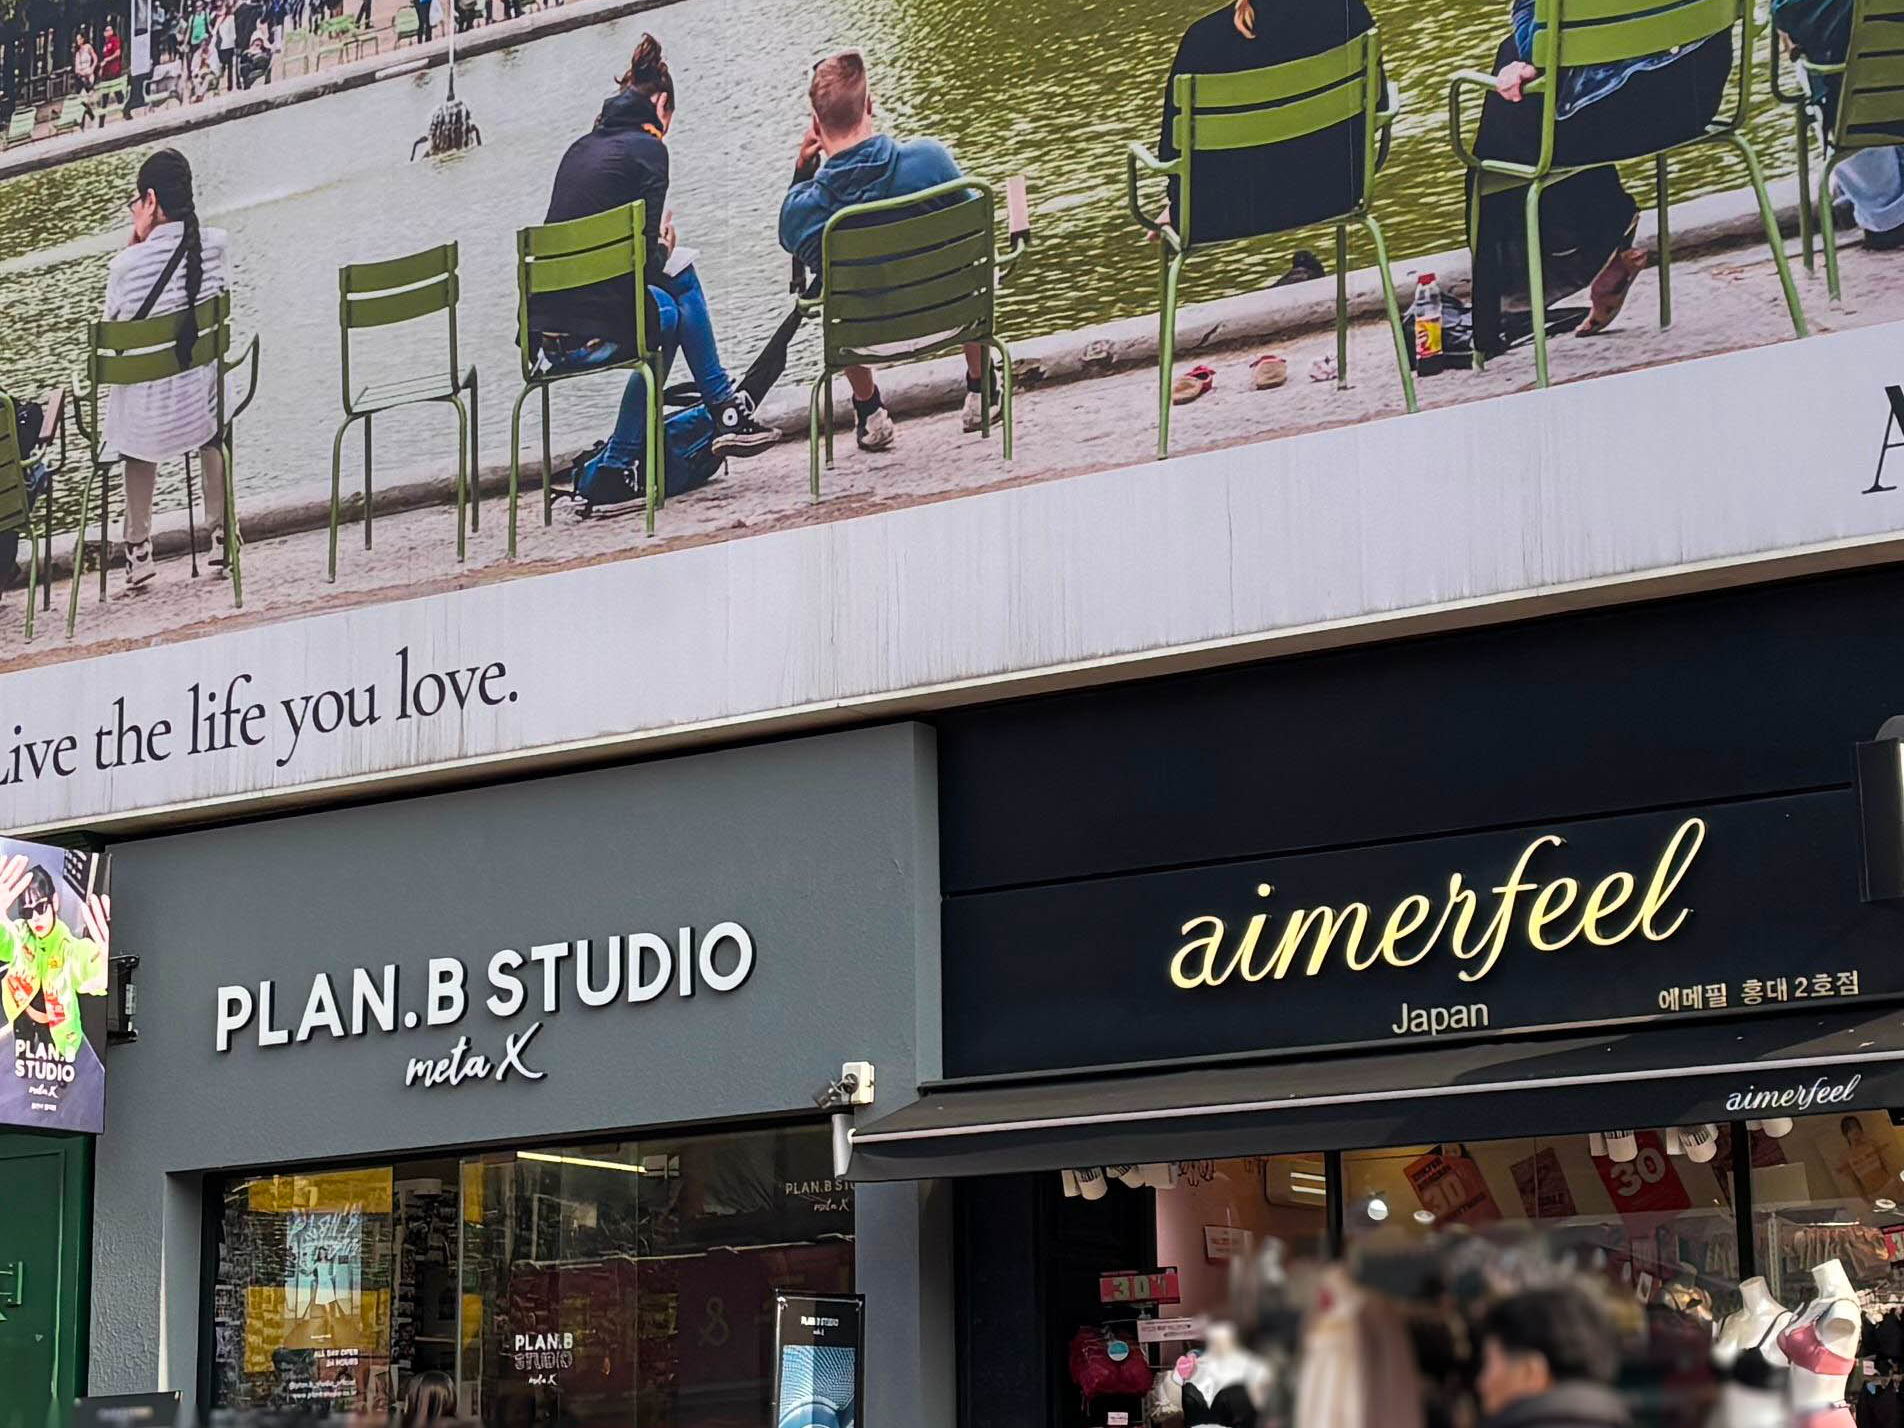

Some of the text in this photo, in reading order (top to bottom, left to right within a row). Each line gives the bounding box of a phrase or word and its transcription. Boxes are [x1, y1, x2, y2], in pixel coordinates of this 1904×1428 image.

[95, 696, 172, 770] the
[187, 673, 266, 755] life
[276, 684, 381, 768] you
[395, 646, 518, 721] love.
[1169, 817, 1707, 990] aimerfeel
[215, 921, 756, 1052] PLAN.B STUDIO
[1658, 982, 1728, 1012] 에메필
[1392, 1001, 1490, 1037] Japan
[14, 1059, 76, 1083] STUDIO
[1725, 1074, 1863, 1112] aimerfeel
[514, 1332, 574, 1352] PLAN.B
